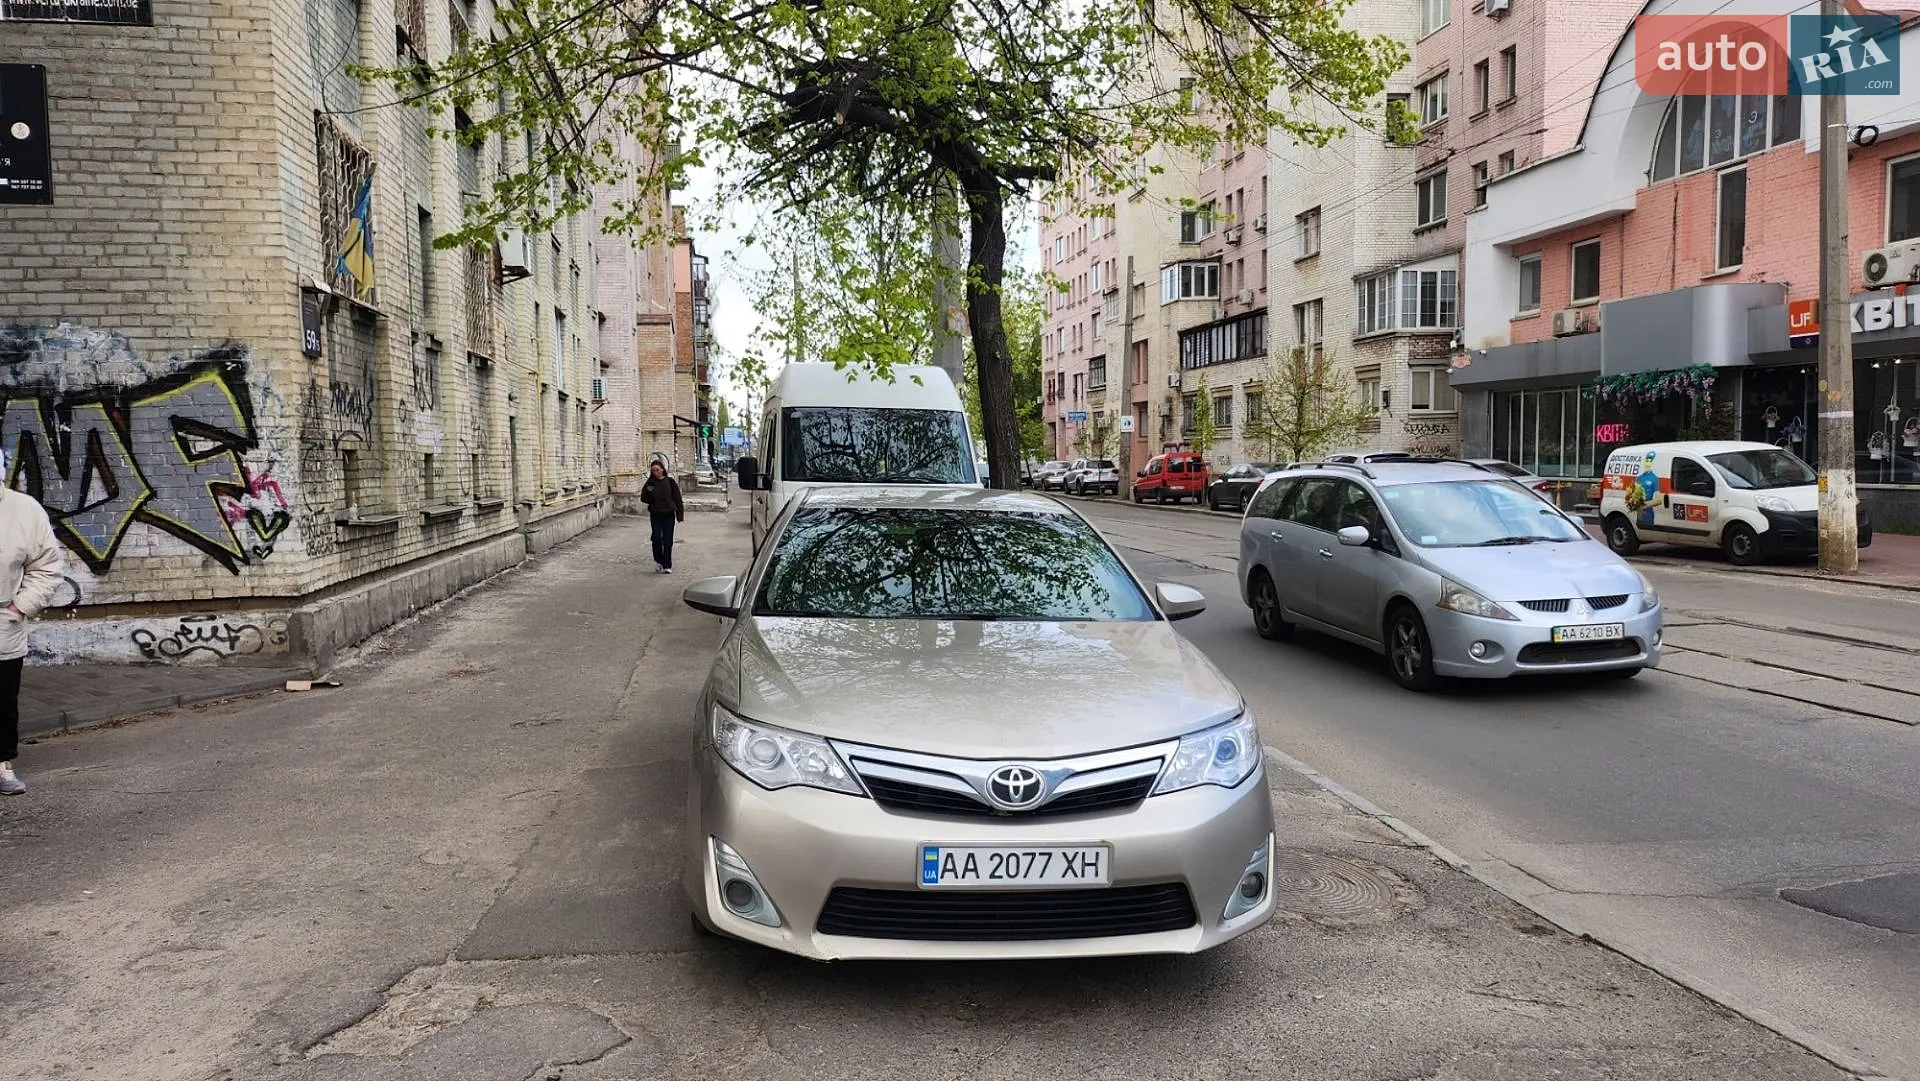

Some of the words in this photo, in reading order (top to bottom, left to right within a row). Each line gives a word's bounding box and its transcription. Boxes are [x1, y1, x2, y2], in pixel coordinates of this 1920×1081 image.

[1607, 463, 1640, 475] КВІТІВ
[1562, 629, 1576, 640] AA
[1580, 626, 1603, 639] 6210
[1606, 625, 1621, 638] BX
[940, 852, 980, 879] AA
[989, 852, 1053, 879] 2077
[1061, 851, 1100, 878] XH
[924, 870, 937, 880] UA
